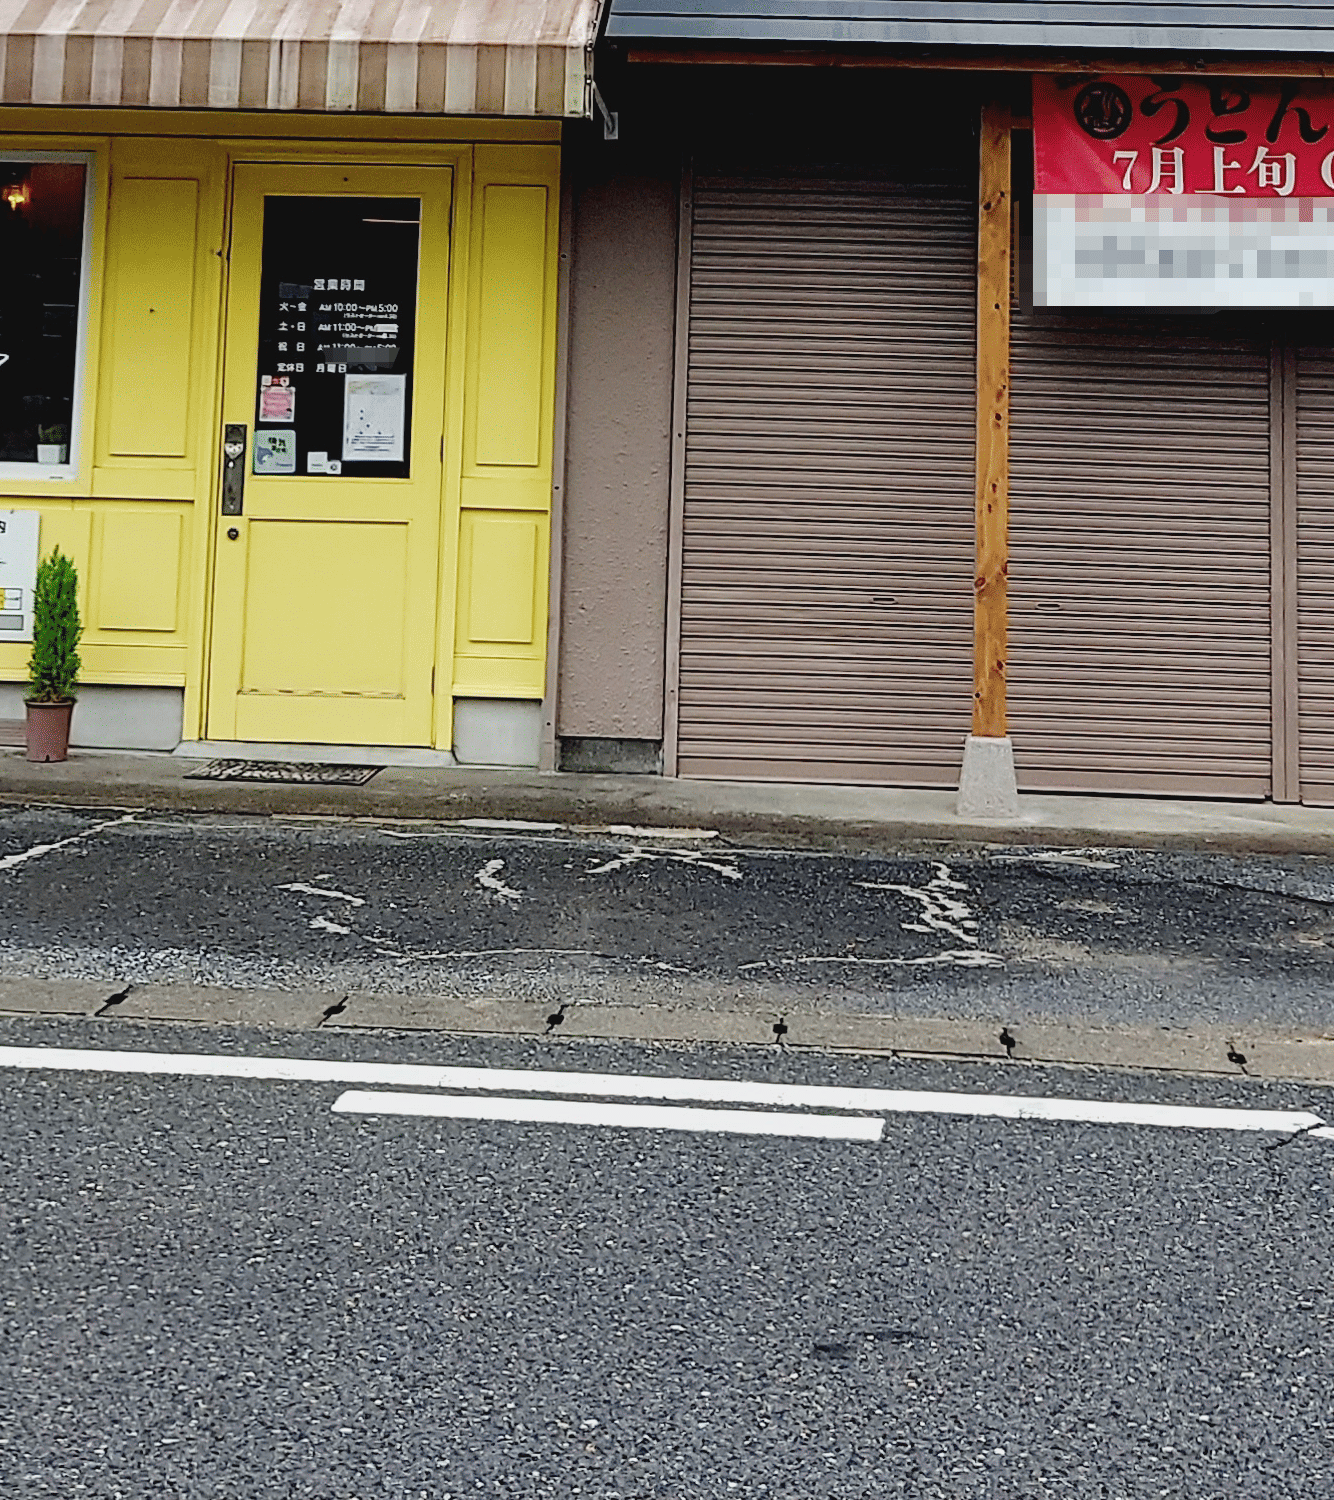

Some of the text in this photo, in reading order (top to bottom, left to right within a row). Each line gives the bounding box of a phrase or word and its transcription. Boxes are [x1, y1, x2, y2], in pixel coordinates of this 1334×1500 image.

[1111, 146, 1296, 197] 7月上旬
[277, 362, 305, 373] 定休日
